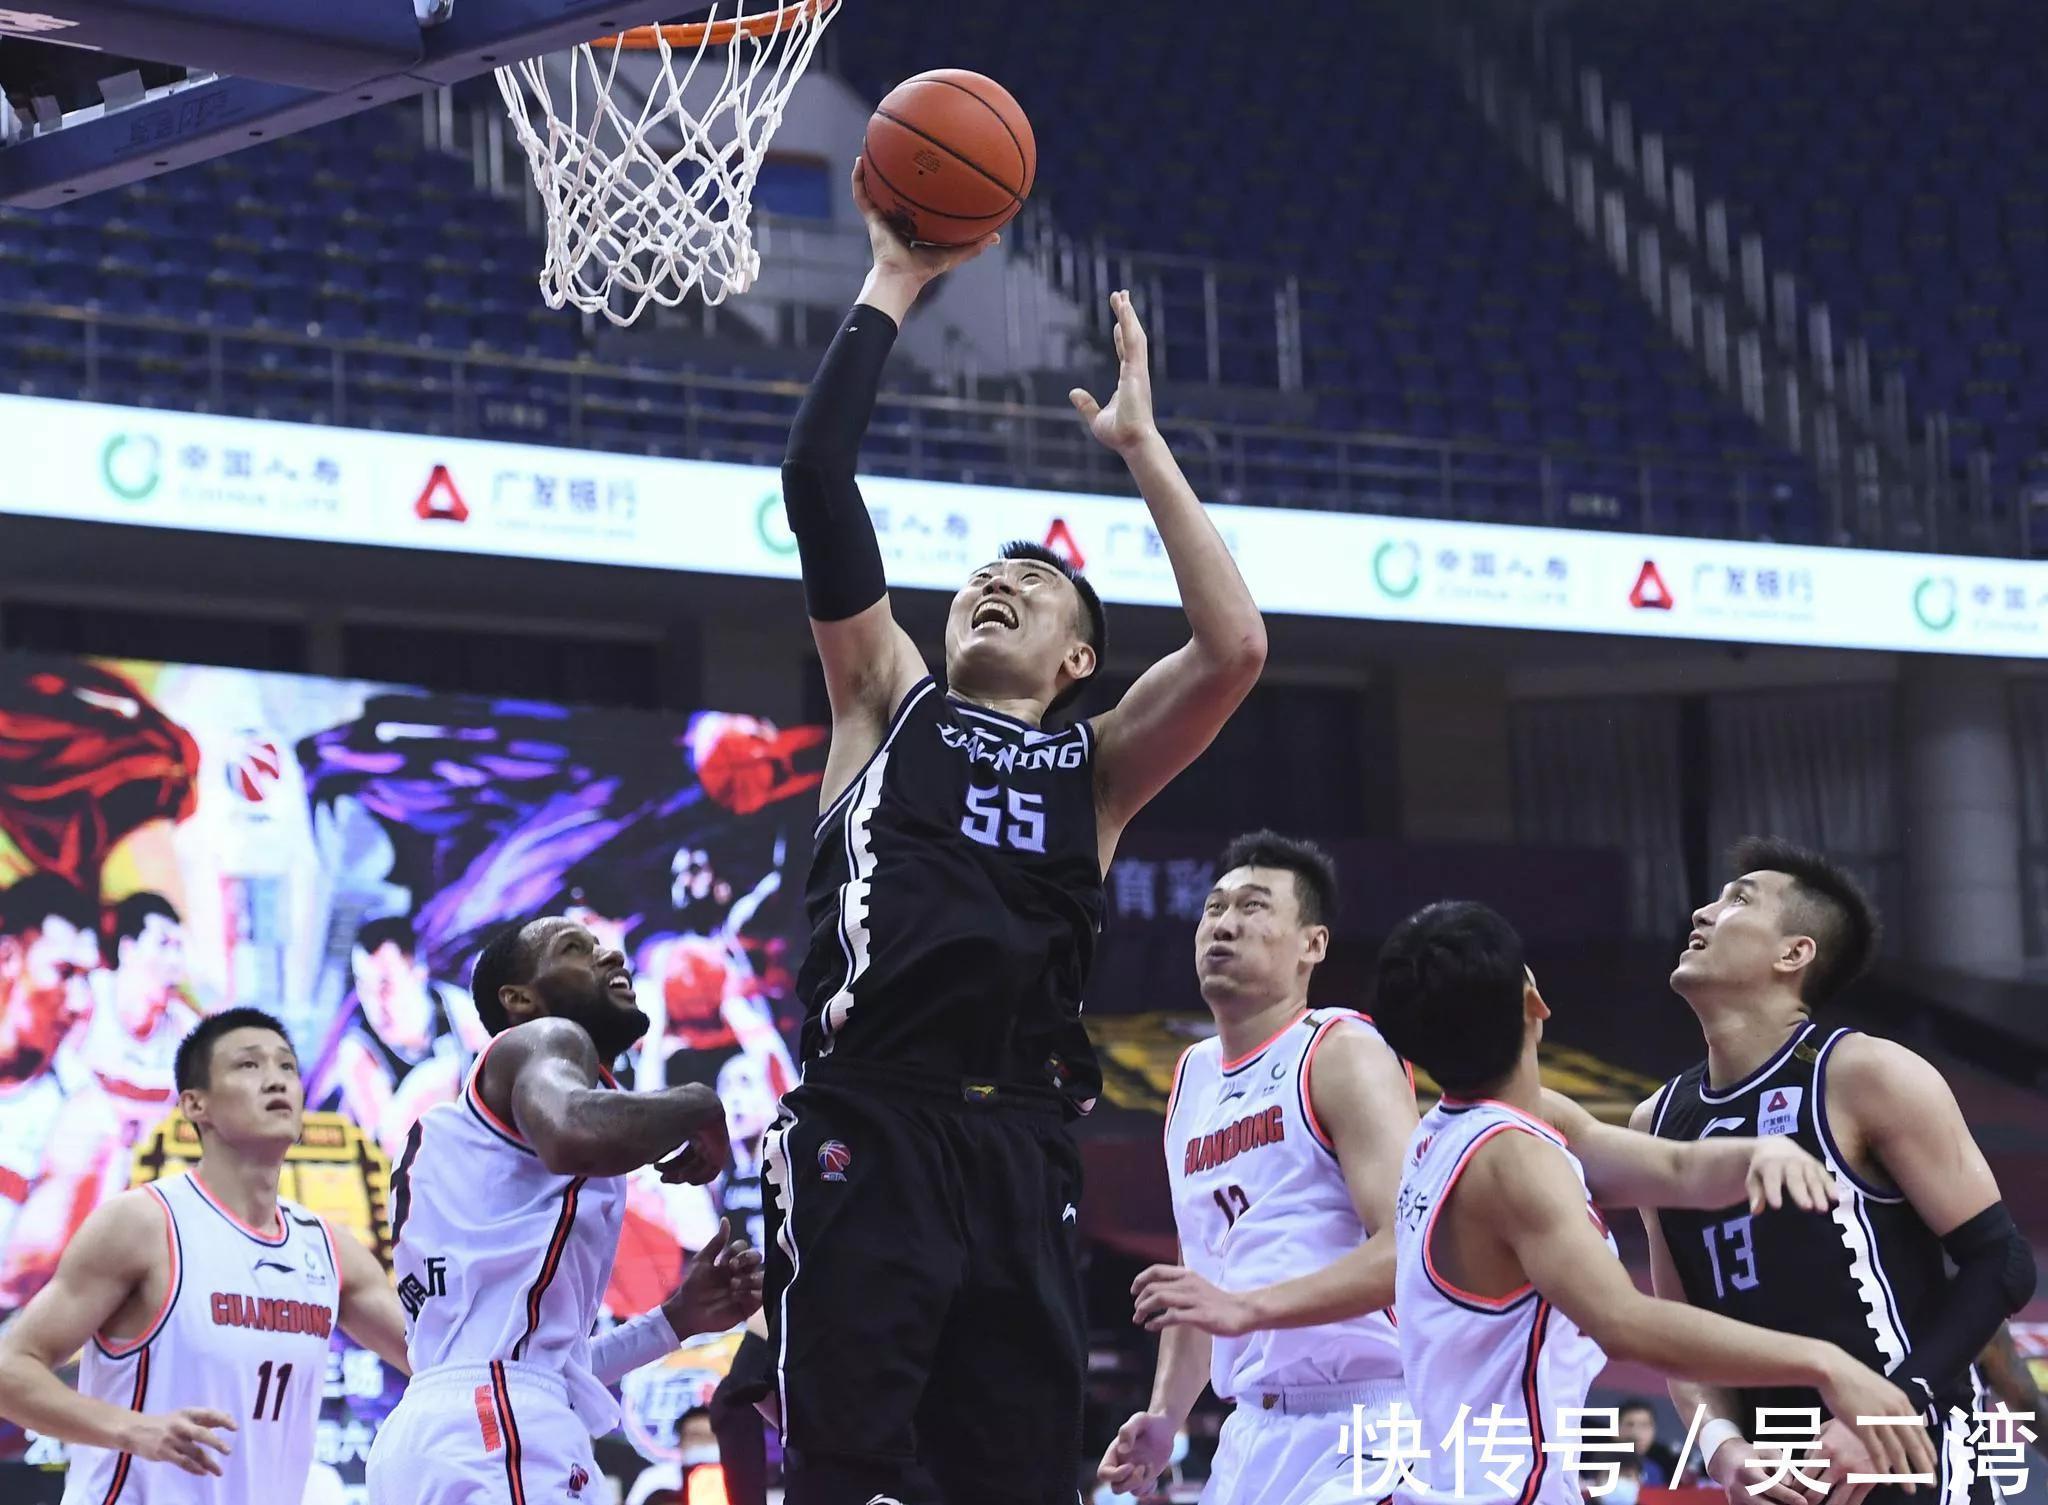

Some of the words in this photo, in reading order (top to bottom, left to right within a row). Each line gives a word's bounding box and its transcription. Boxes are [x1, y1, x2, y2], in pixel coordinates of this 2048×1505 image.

[181, 444, 341, 487] 中国人寿
[493, 467, 638, 521] 广发银行
[1437, 548, 1569, 583] 中国人寿
[1693, 560, 1815, 605] 广发银行
[961, 782, 1046, 854] 55
[1768, 1125, 1786, 1136] CGB
[1702, 1214, 1759, 1299] 13
[210, 1291, 332, 1340] GUANGDONG
[252, 1360, 293, 1422] 11
